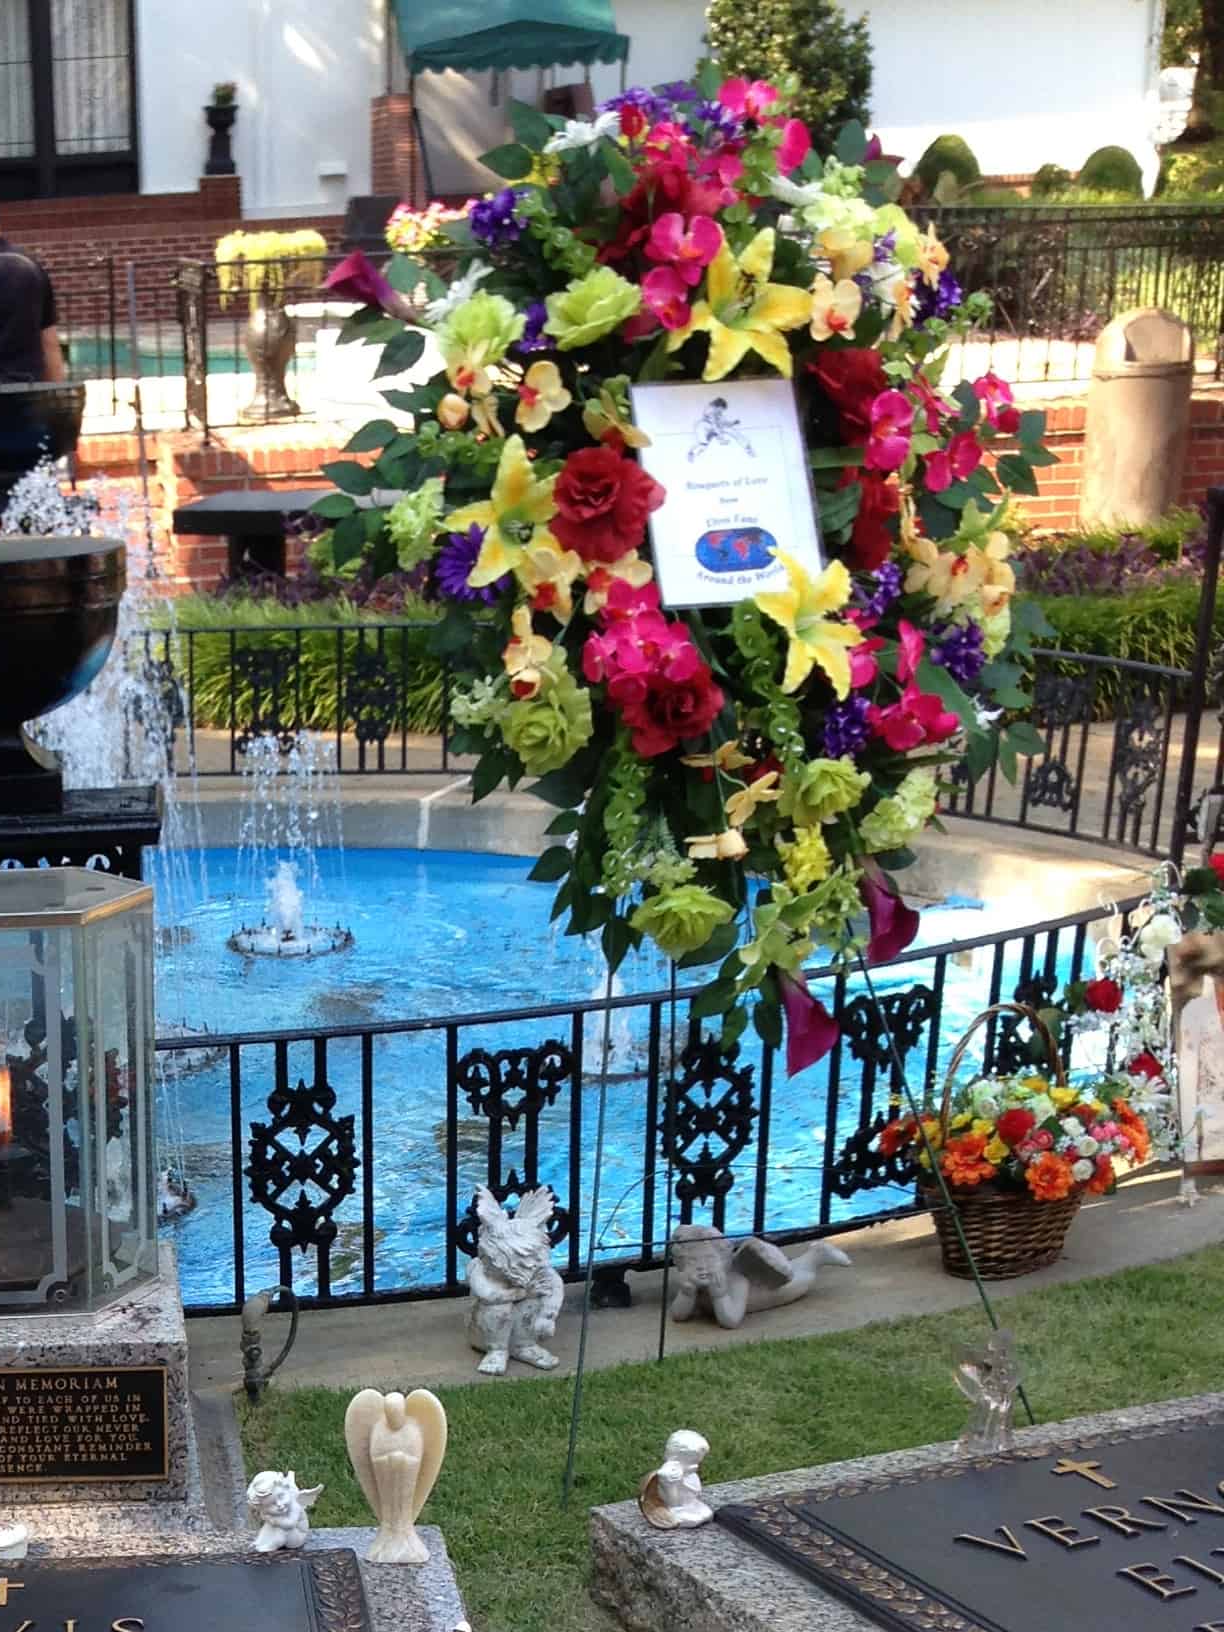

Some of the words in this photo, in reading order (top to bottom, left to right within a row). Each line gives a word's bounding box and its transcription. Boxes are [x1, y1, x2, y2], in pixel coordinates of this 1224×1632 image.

[15, 1376, 118, 1391] MEMORIAM
[15, 1396, 31, 1404] TO
[38, 1395, 73, 1404] EACH
[81, 1394, 97, 1403] OF
[104, 1394, 120, 1403] US
[127, 1393, 141, 1402] IN
[27, 1415, 59, 1424] TIED
[68, 1414, 103, 1423] WITH
[63, 1452, 128, 1462] ETERNAL
